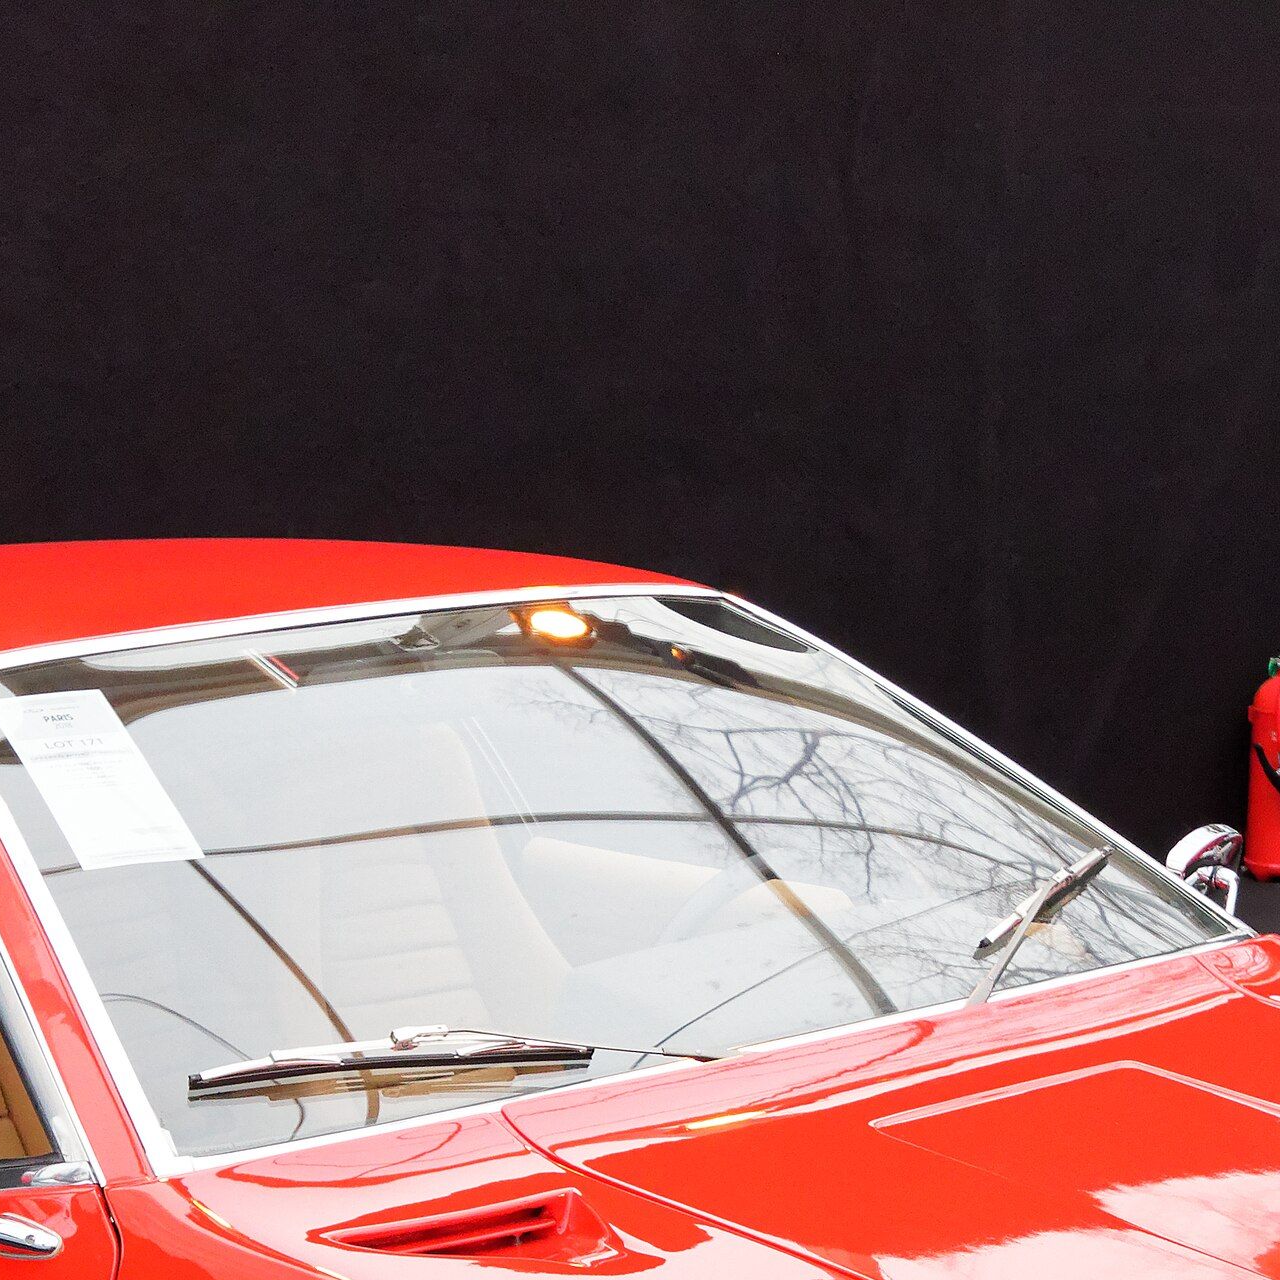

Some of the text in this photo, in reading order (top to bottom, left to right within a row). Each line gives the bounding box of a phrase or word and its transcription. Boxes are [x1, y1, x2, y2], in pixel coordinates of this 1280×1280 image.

[43, 713, 74, 723] PARIS
[43, 738, 103, 750] LOT 171
